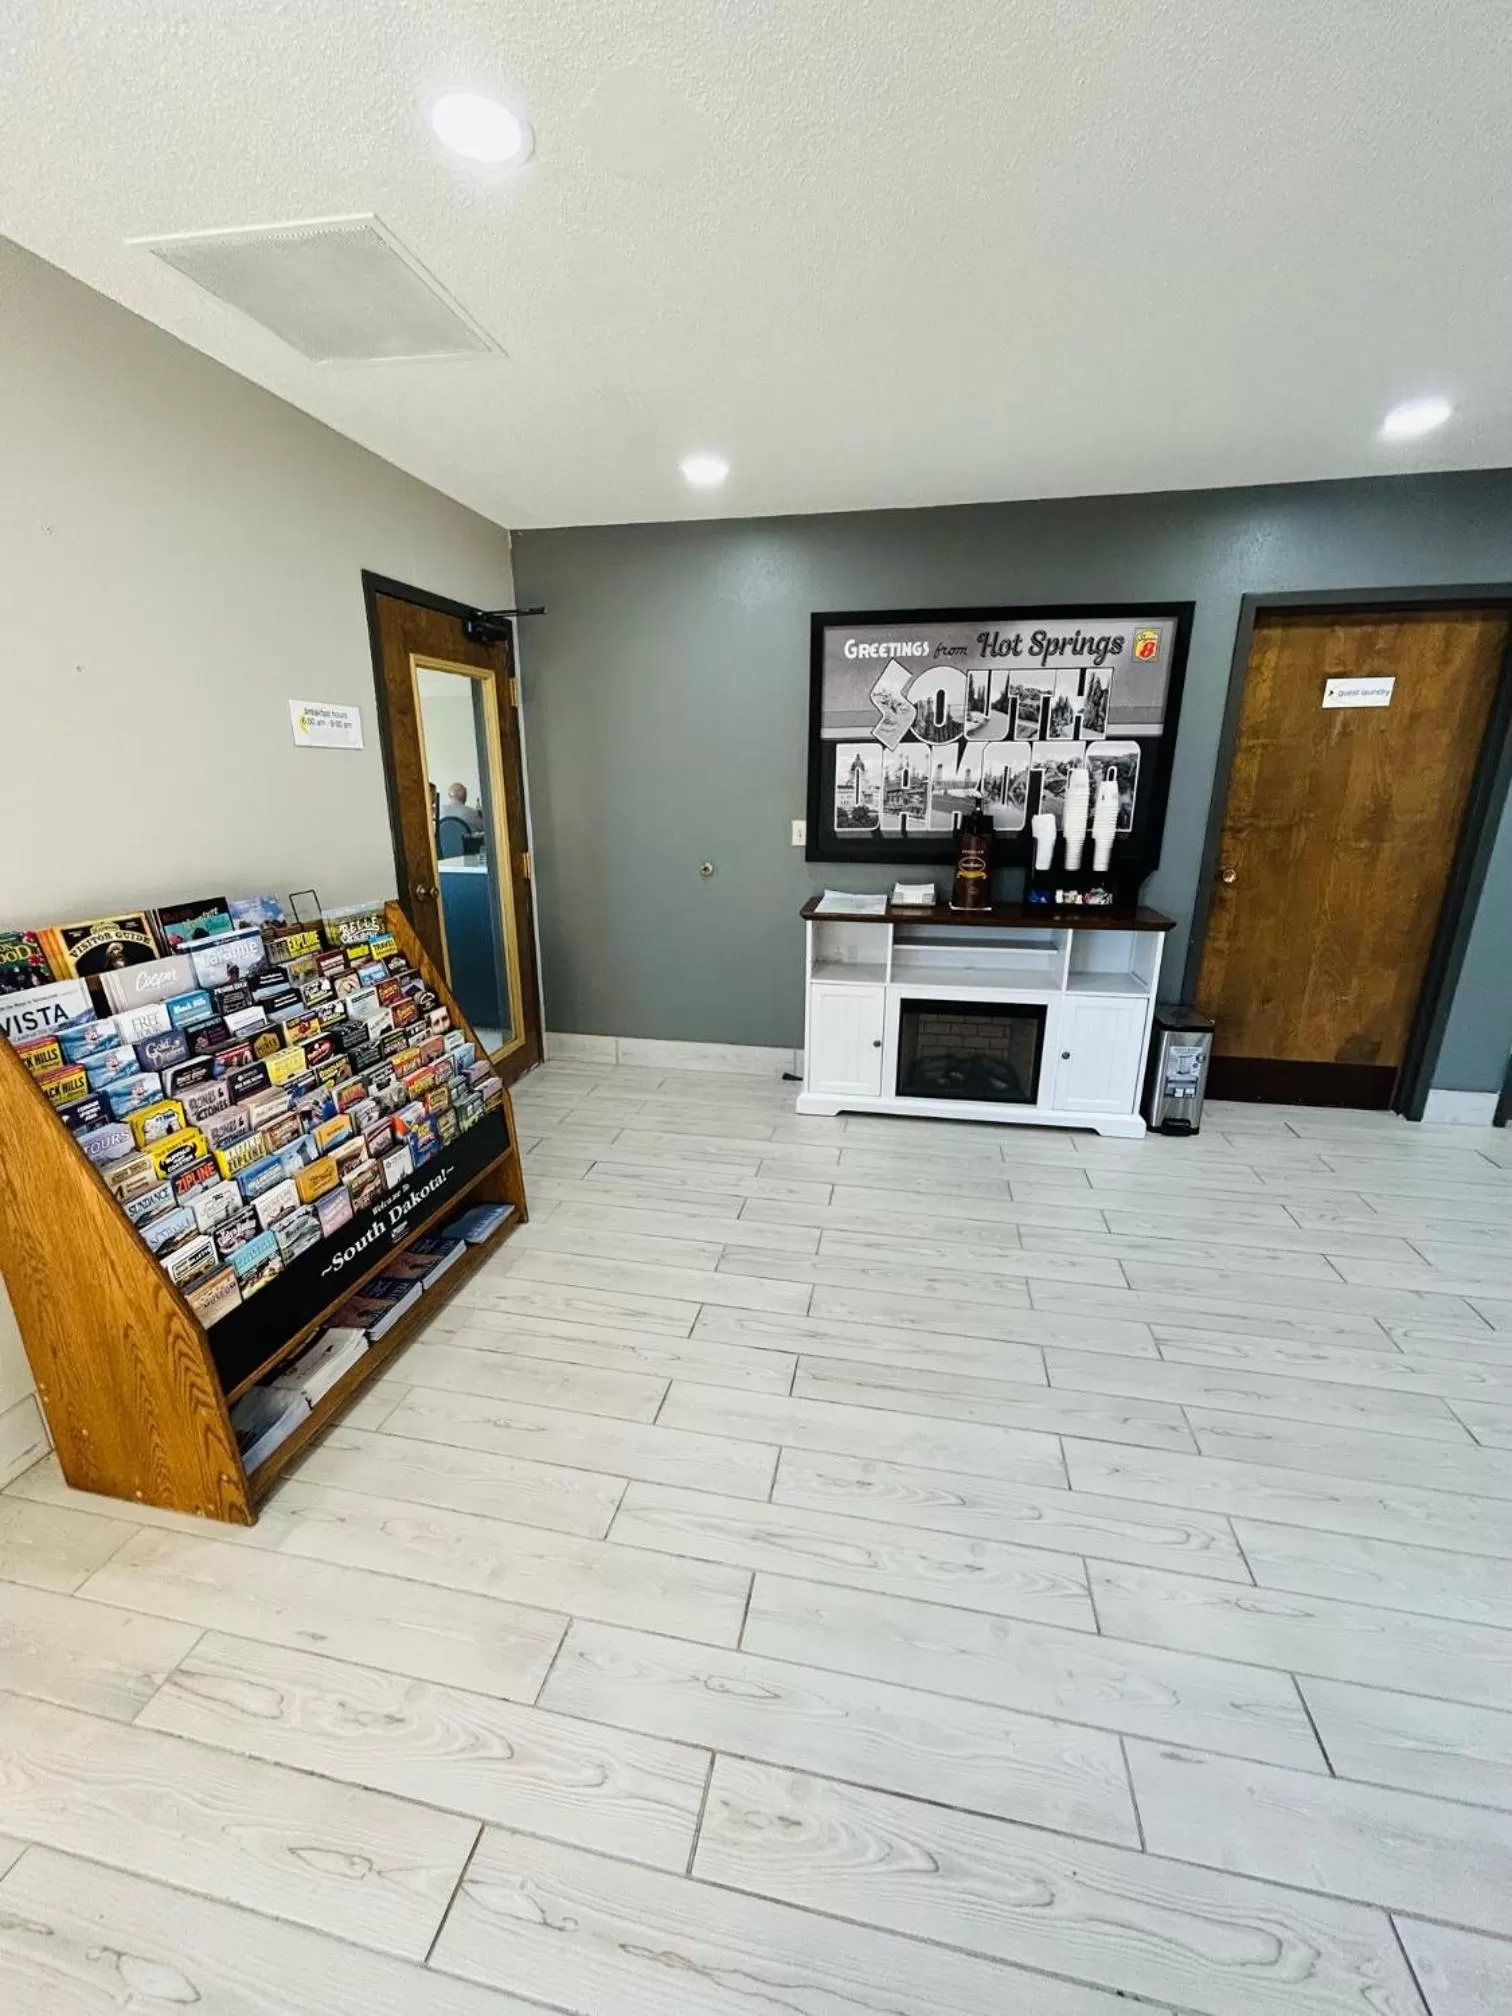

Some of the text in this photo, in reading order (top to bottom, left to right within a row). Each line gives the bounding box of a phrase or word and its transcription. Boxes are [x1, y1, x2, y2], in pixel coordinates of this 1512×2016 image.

[932, 641, 968, 660] from
[976, 630, 1024, 658] Hot
[1027, 628, 1126, 667] Springs
[870, 657, 1114, 753] SOUTH
[70, 931, 151, 958] VISITOR GUIDE
[0, 1003, 69, 1037] VISTA
[34, 1049, 59, 1064] HILLS
[62, 1077, 85, 1094] HILLS
[175, 1160, 216, 1194] ZIPLINE
[128, 1187, 170, 1218] SUNDANCE
[372, 1189, 401, 1216] Welcome
